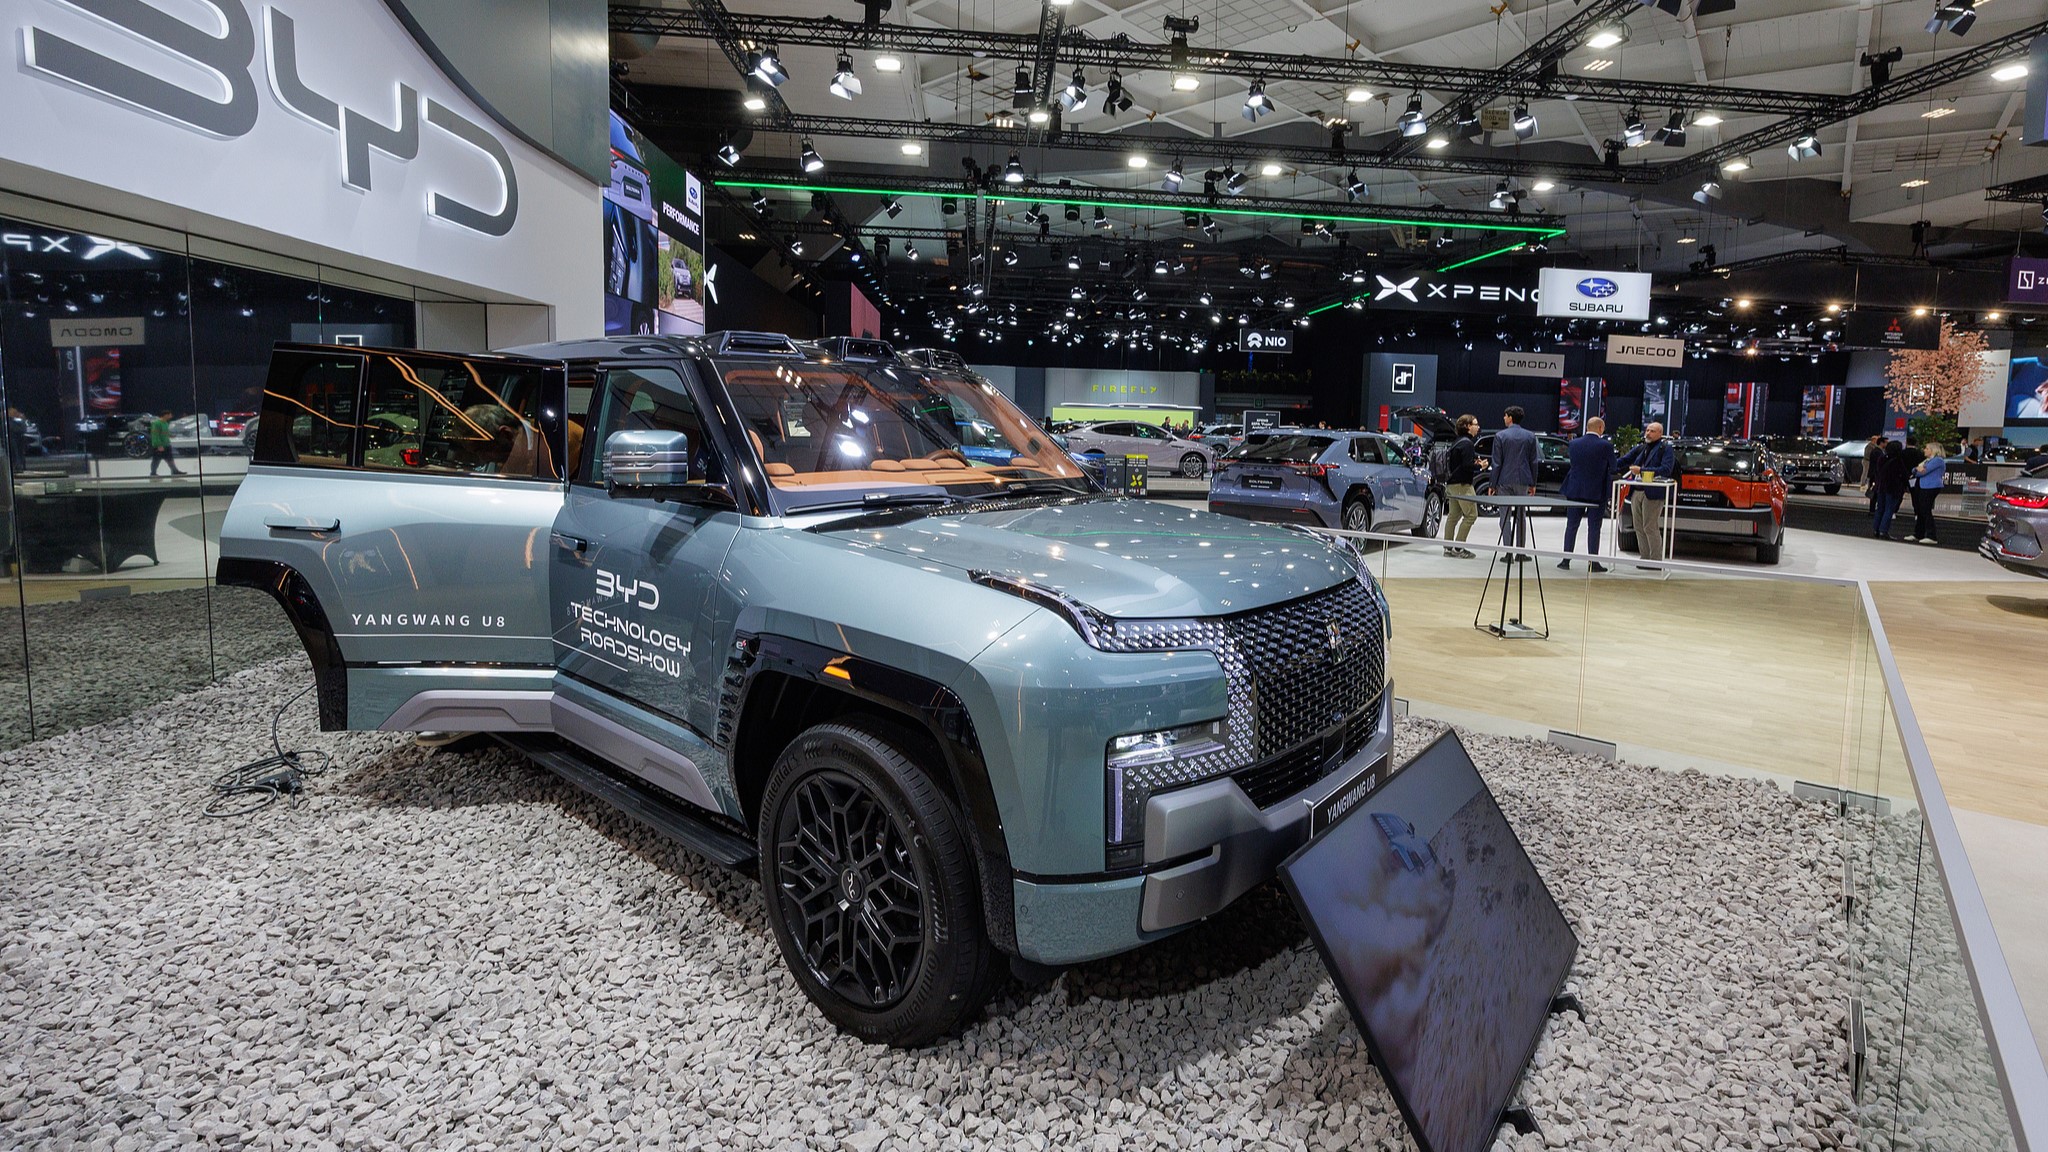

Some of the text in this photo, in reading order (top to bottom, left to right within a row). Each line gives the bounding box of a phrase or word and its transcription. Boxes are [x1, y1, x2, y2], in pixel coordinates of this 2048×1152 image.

[662, 201, 700, 236] PERFORMANCE
[1568, 301, 1624, 313] SUBARU
[1264, 336, 1287, 347] NIO
[1616, 345, 1676, 358] JAECOO
[1506, 358, 1558, 370] OMODA
[1395, 371, 1412, 385] dr
[1092, 384, 1158, 395] FIREFLY
[595, 568, 660, 611] BYD
[351, 613, 506, 628] YANGWANG U8
[570, 601, 691, 657] TECHNOLOGY
[580, 626, 681, 678] ROADSHOW
[1327, 773, 1376, 824] YANGWANG U8
